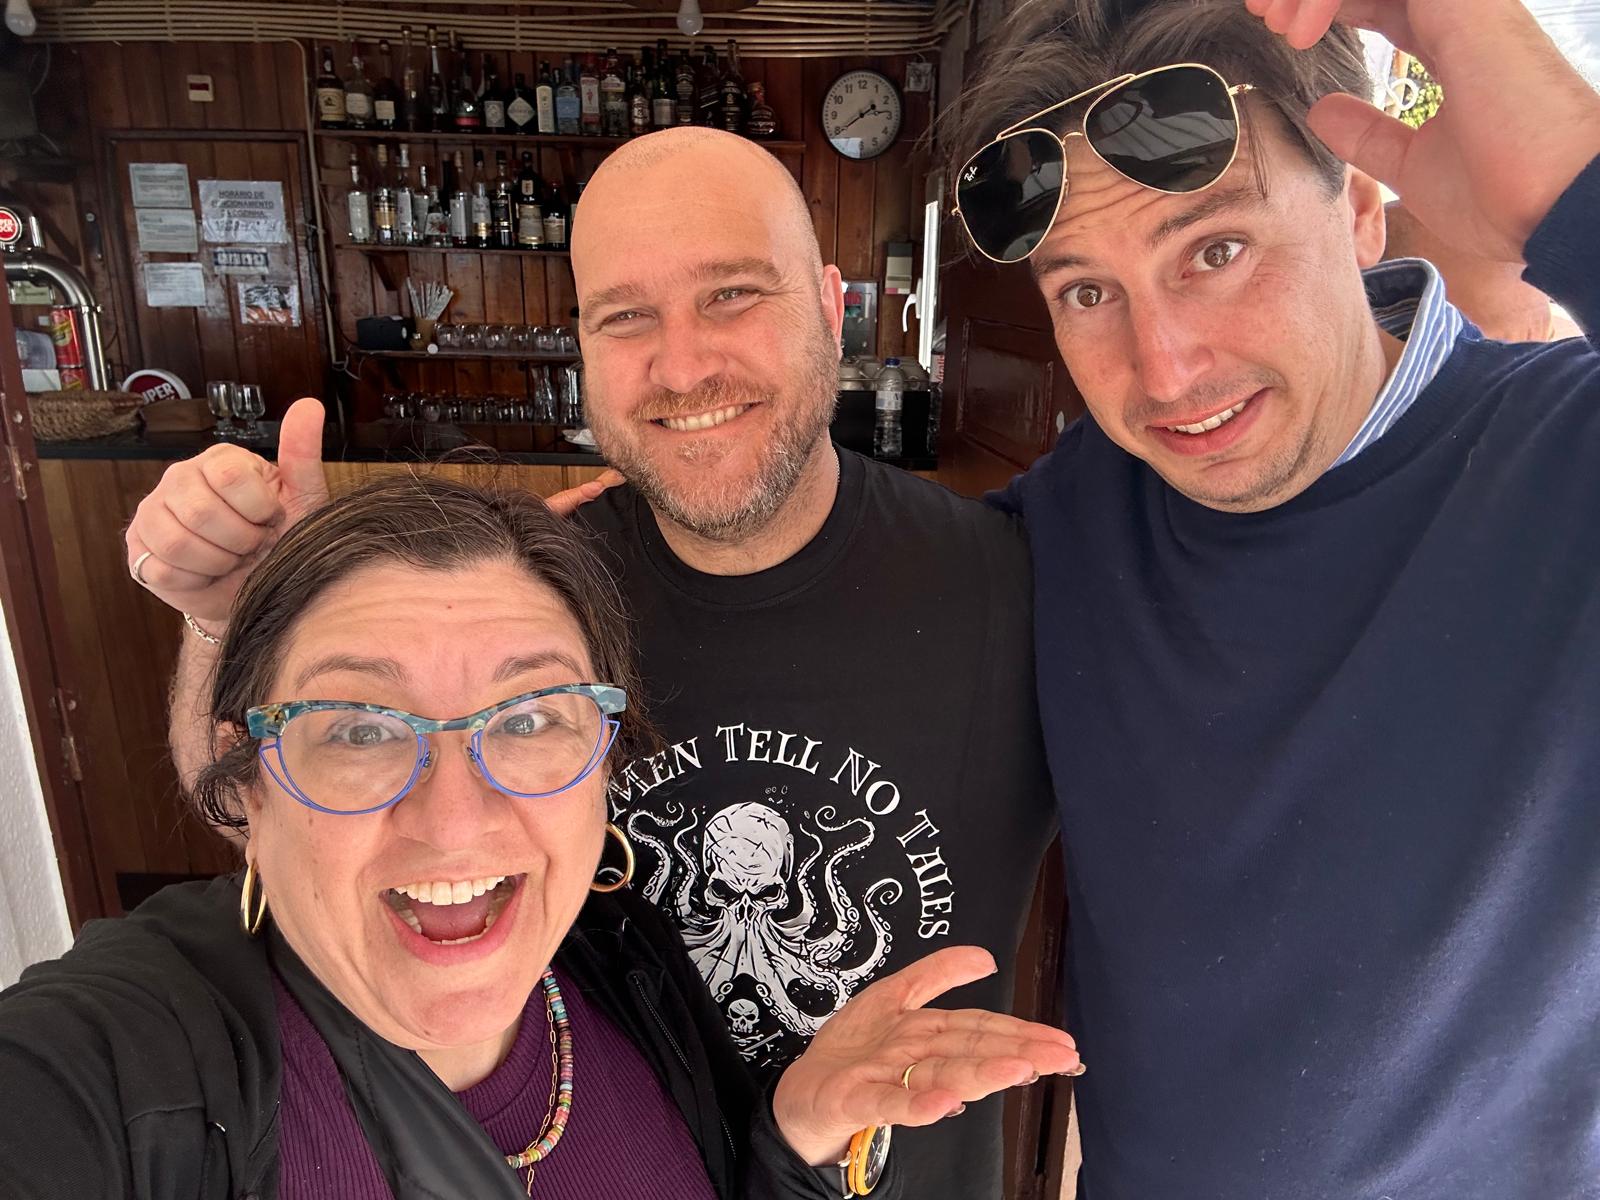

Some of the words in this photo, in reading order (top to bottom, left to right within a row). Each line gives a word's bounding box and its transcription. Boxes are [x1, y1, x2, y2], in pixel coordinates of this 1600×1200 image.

[845, 84, 853, 94] 11
[858, 80, 868, 90] 12
[833, 95, 844, 105] 10
[883, 95, 890, 105] 2
[831, 110, 838, 120] 9
[886, 110, 893, 120] 3
[834, 126, 841, 136] 8
[882, 126, 889, 135] 4
[872, 137, 879, 147] 5
[142, 382, 175, 406] UPER
[608, 736, 703, 821] MEN
[715, 722, 823, 775] TELL
[829, 747, 900, 816] NO
[896, 809, 956, 939] TALES
